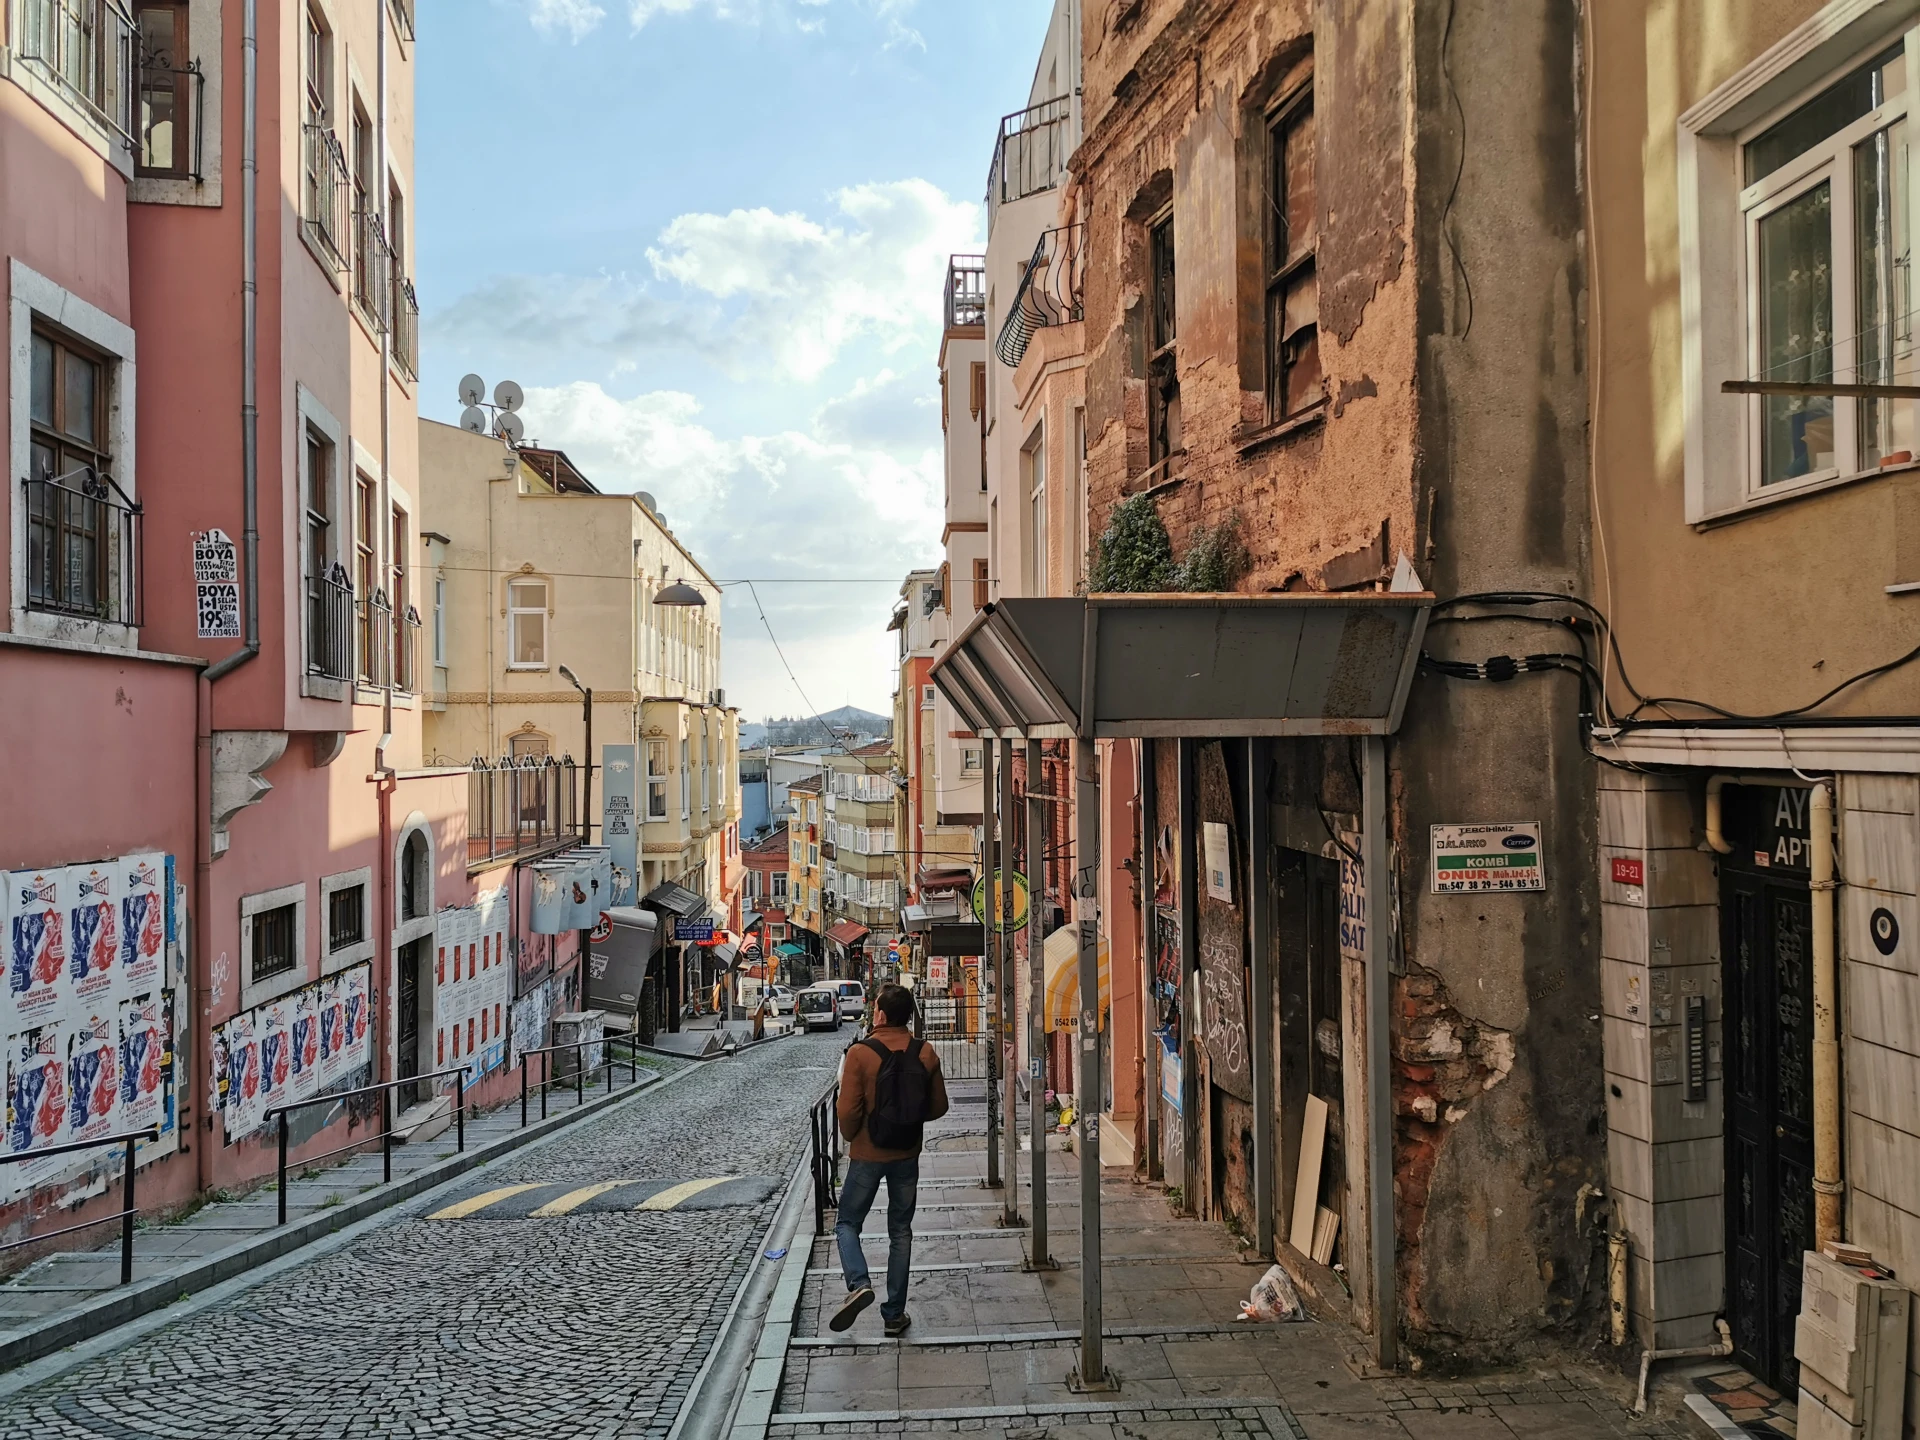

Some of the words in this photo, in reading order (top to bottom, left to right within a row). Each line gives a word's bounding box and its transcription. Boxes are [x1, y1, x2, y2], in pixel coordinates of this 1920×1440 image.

[195, 531, 210, 543] +1
[196, 549, 234, 560] BOYA
[195, 561, 212, 570] 0555
[197, 585, 237, 597] BOYA
[198, 597, 217, 610] 1+1
[199, 610, 223, 628] 195
[1458, 825, 1514, 834] TERCİHİMİZ
[1445, 838, 1487, 849] ALARKO
[1506, 839, 1532, 847] Carrier
[1466, 855, 1509, 867] KOMBİ
[1341, 859, 1366, 893] EŞY
[1438, 869, 1489, 880] ONUR
[1616, 863, 1640, 879] 19-21
[1468, 880, 1478, 889] 38
[1517, 879, 1526, 888] 85
[1530, 878, 1540, 887] 93
[677, 918, 711, 926] SESER
[1340, 922, 1366, 951] SAT
[931, 968, 940, 979] 80
[1054, 1018, 1070, 1027] 0542
